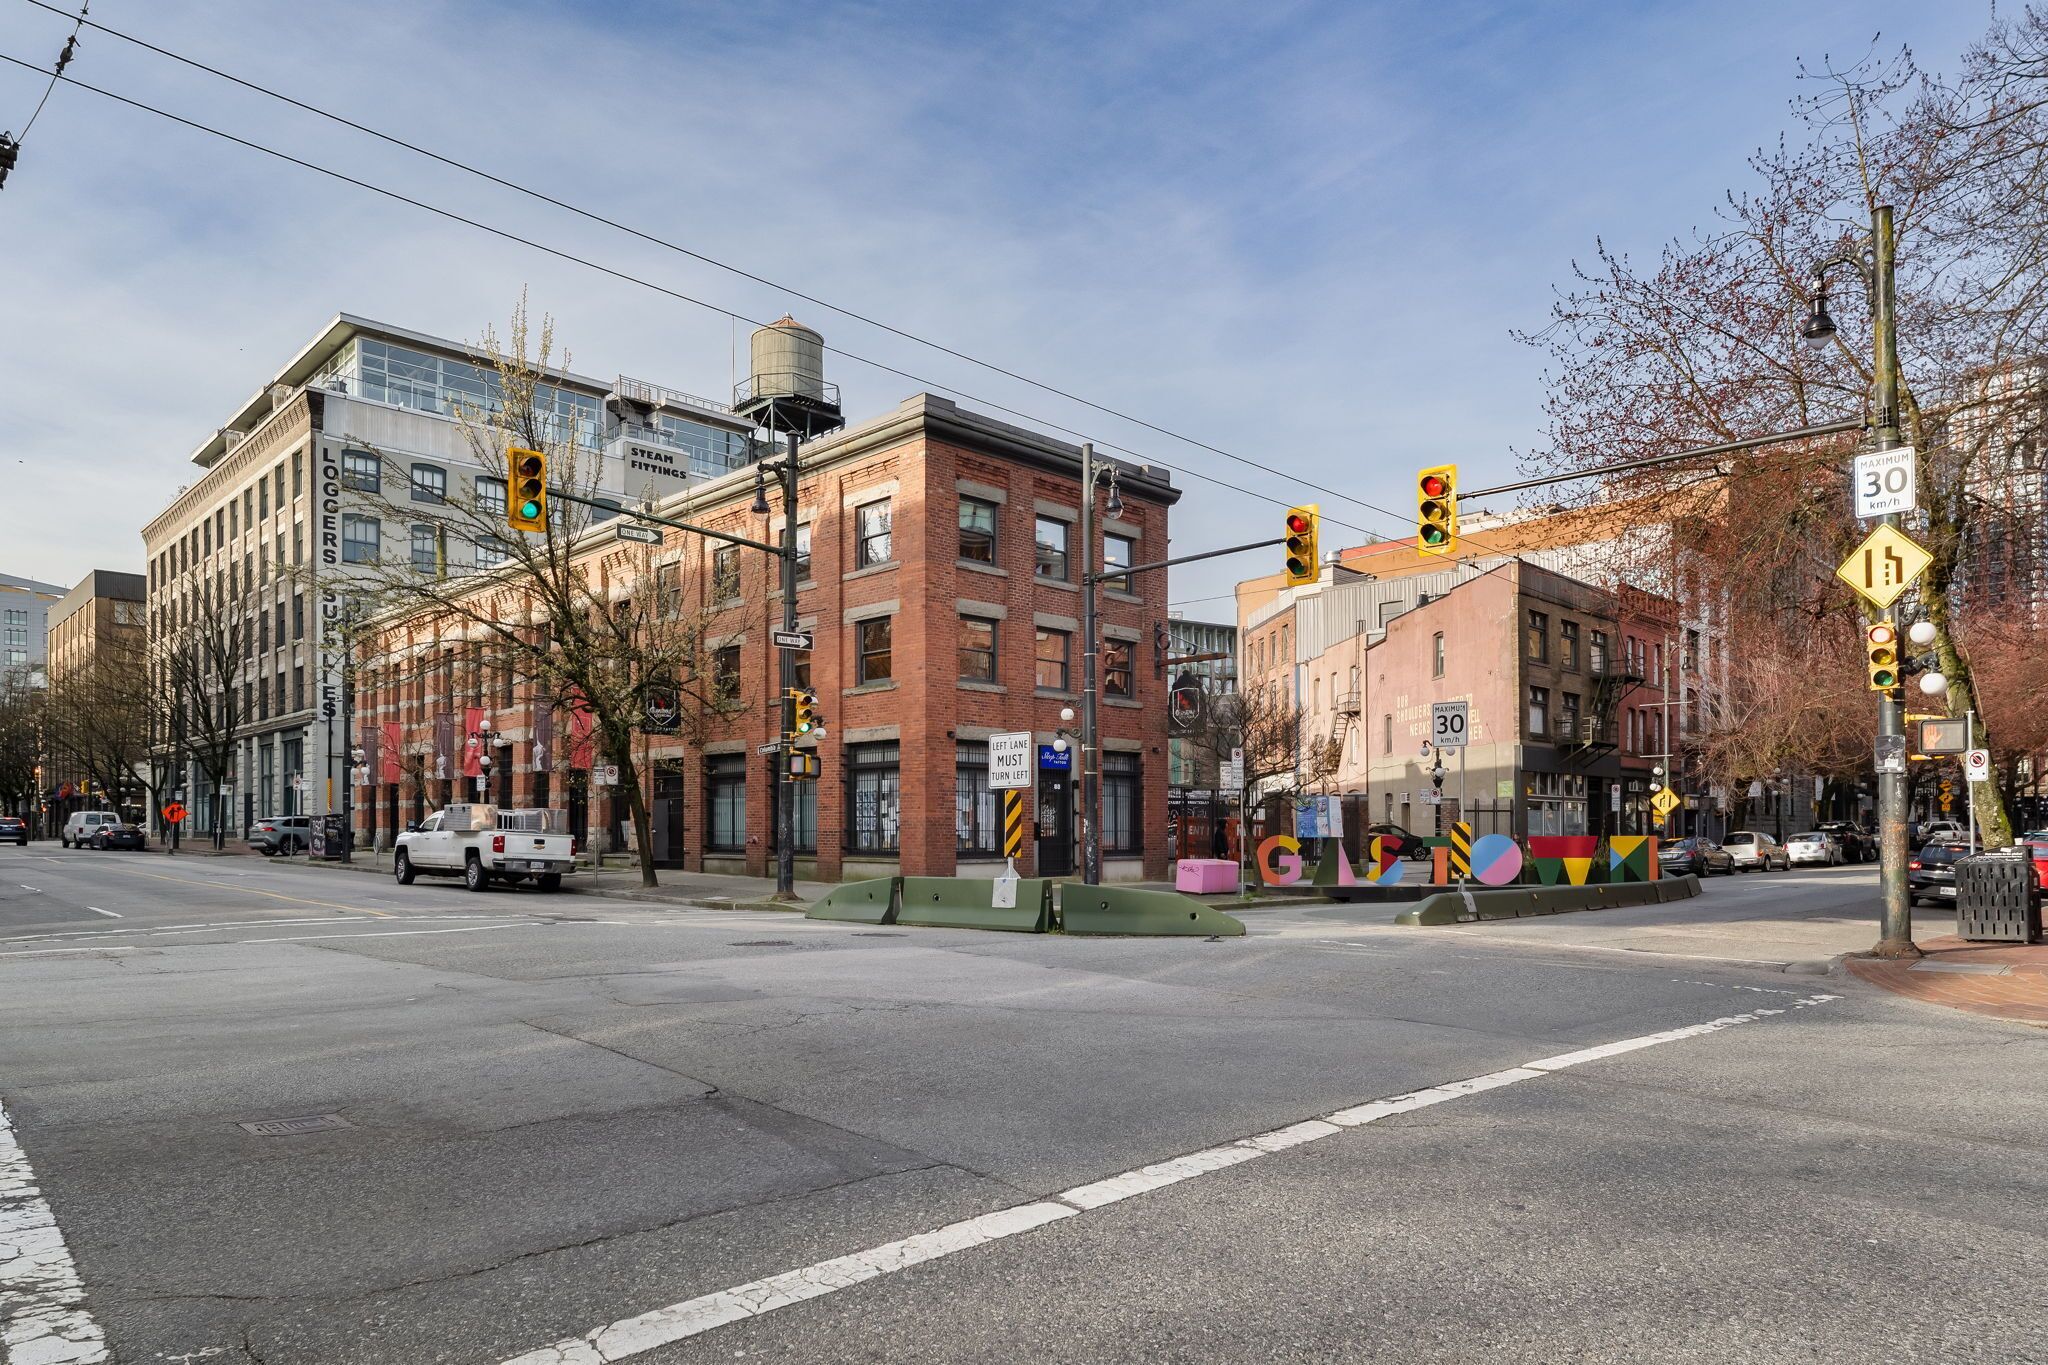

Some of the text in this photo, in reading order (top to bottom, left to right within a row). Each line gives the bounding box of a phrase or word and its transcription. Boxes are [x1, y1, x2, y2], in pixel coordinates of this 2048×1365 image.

[630, 447, 674, 464] STEAM
[1860, 453, 1909, 470] MAXIMUM
[631, 460, 687, 479] FITTINGS
[1863, 466, 1908, 498] 30
[322, 447, 339, 565] LOGGERS
[1869, 497, 1900, 510] km/h
[621, 528, 649, 539] ONE WAY
[777, 635, 788, 643] ONE
[1396, 703, 1431, 724] SHOULDERS
[1434, 704, 1466, 713] MAXIMUM
[1409, 720, 1431, 737] NECKS
[1436, 713, 1465, 735] 30
[992, 739, 1028, 751] LEFT LANE
[1440, 736, 1460, 744] km/h
[997, 753, 1023, 767] MUST
[992, 770, 1029, 781] TURN LEFT
[1256, 834, 1658, 886] GASTOWN
